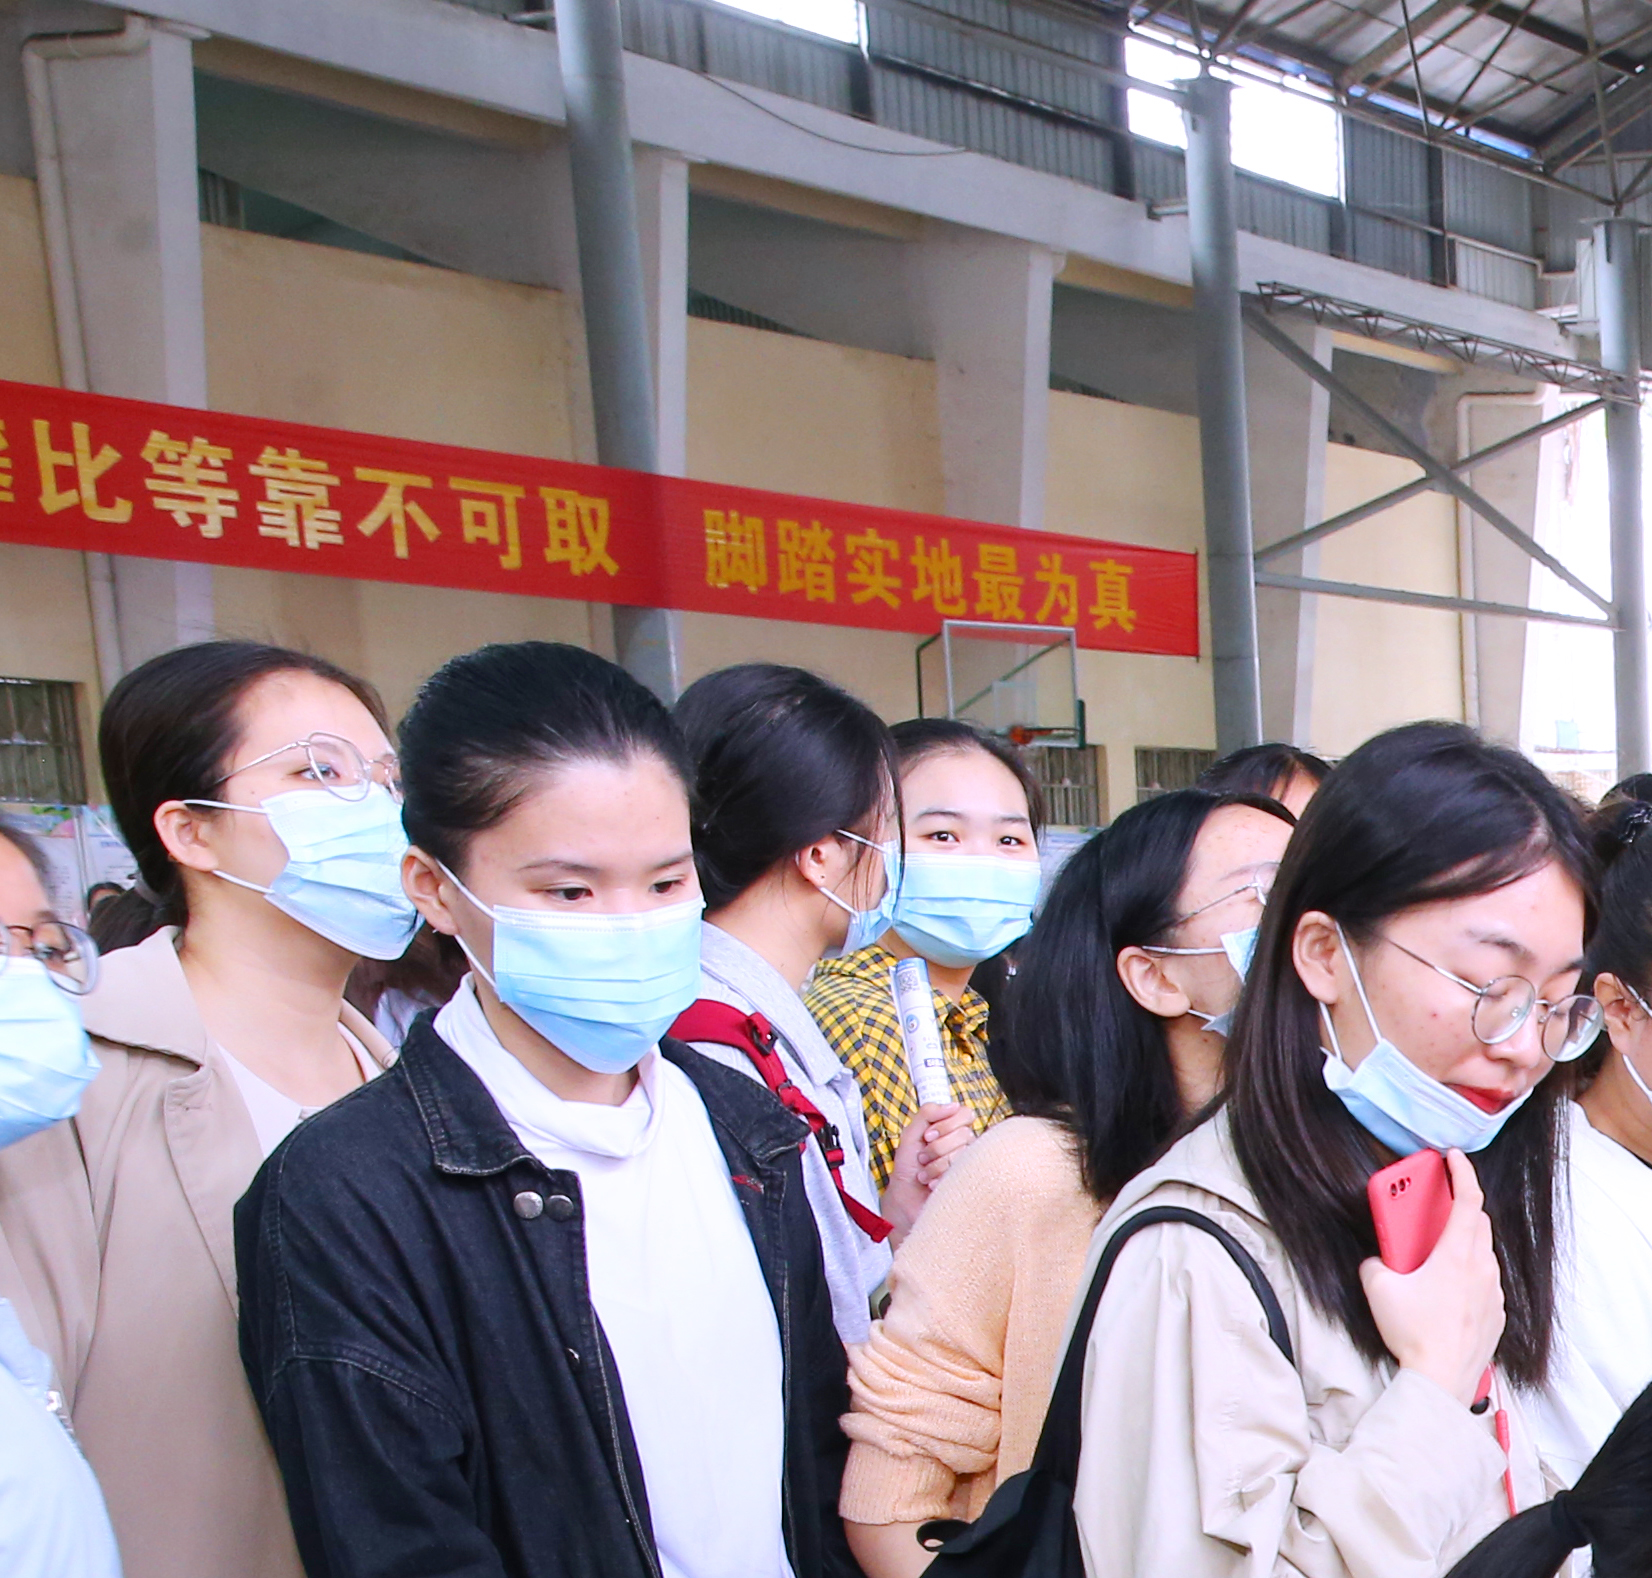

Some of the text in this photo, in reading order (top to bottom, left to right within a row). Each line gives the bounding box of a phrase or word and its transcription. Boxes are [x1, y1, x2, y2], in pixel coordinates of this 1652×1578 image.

[705, 507, 1136, 633] 脚踏实地最为真
